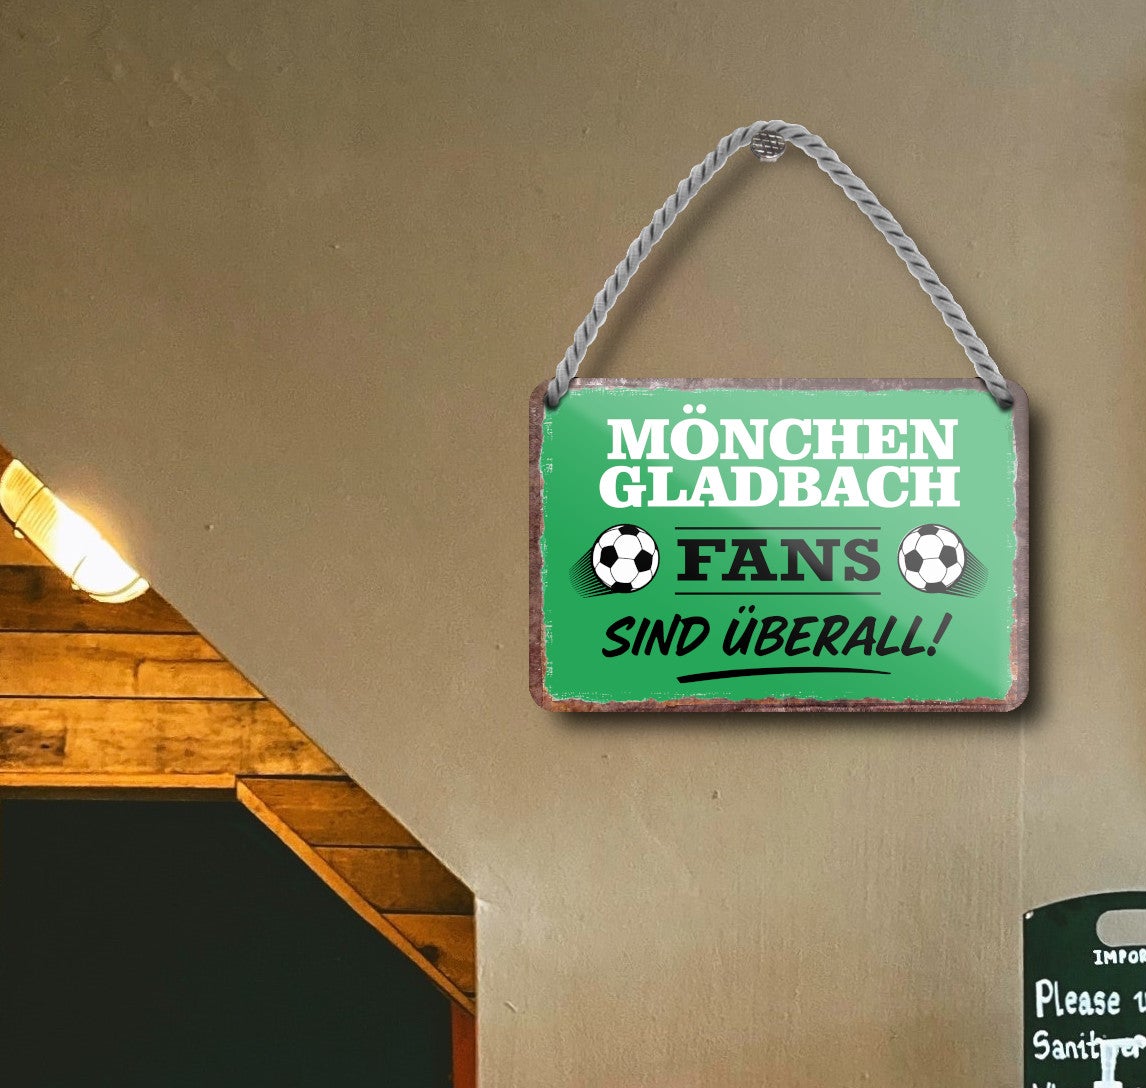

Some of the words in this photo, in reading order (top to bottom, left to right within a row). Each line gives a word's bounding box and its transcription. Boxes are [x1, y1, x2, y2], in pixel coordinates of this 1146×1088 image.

[606, 403, 959, 461] MÖNCHEN
[599, 465, 961, 509] GLADBACH
[676, 538, 882, 582] FANS
[601, 613, 711, 658] SIND
[722, 604, 954, 657] ÜBERALL!
[1035, 977, 1121, 1019] Please
